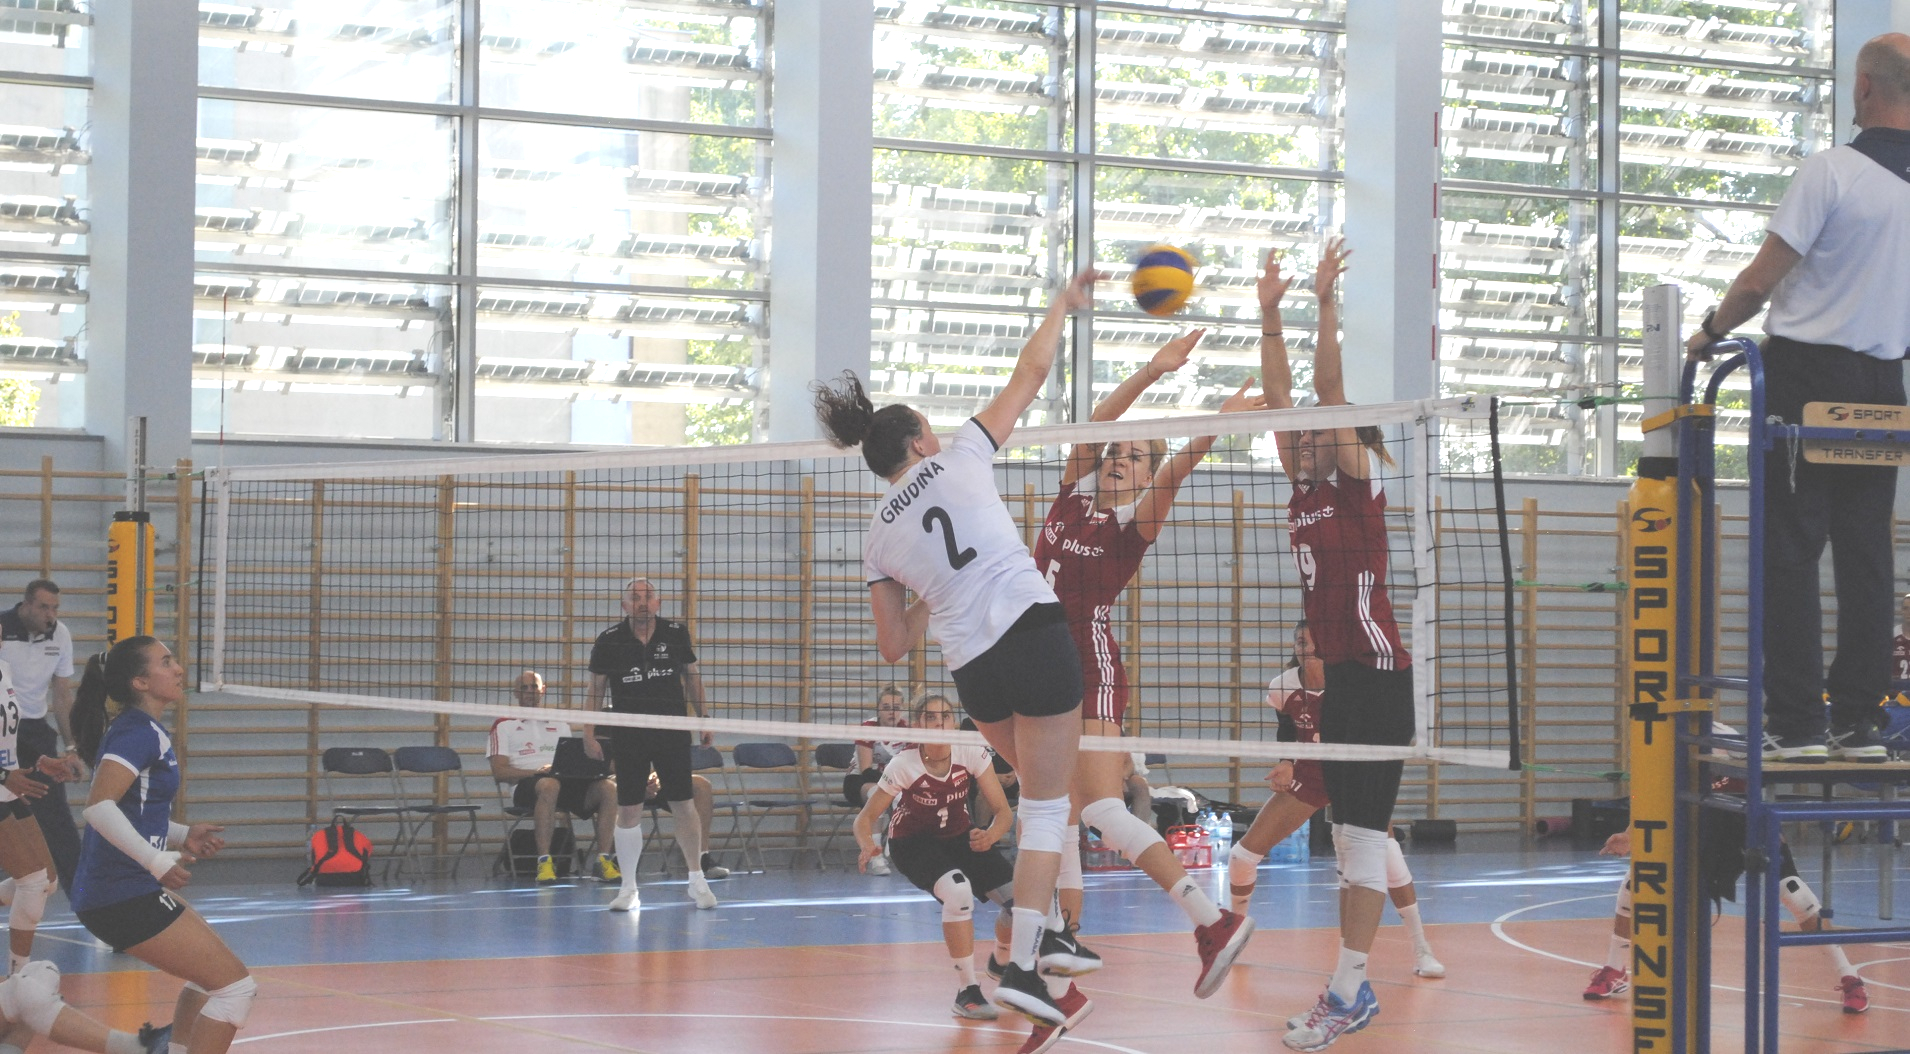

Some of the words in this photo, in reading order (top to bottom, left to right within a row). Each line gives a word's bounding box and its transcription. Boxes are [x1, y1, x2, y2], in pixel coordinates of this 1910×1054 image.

[1853, 409, 1902, 421] SPORT
[1822, 448, 1903, 461] TRANSFER
[880, 461, 945, 524] GRUDINA
[922, 506, 978, 571] 2
[1634, 546, 1668, 745] SPORT
[0, 701, 19, 737] 13
[936, 807, 949, 829] 1
[159, 892, 177, 911] 17
